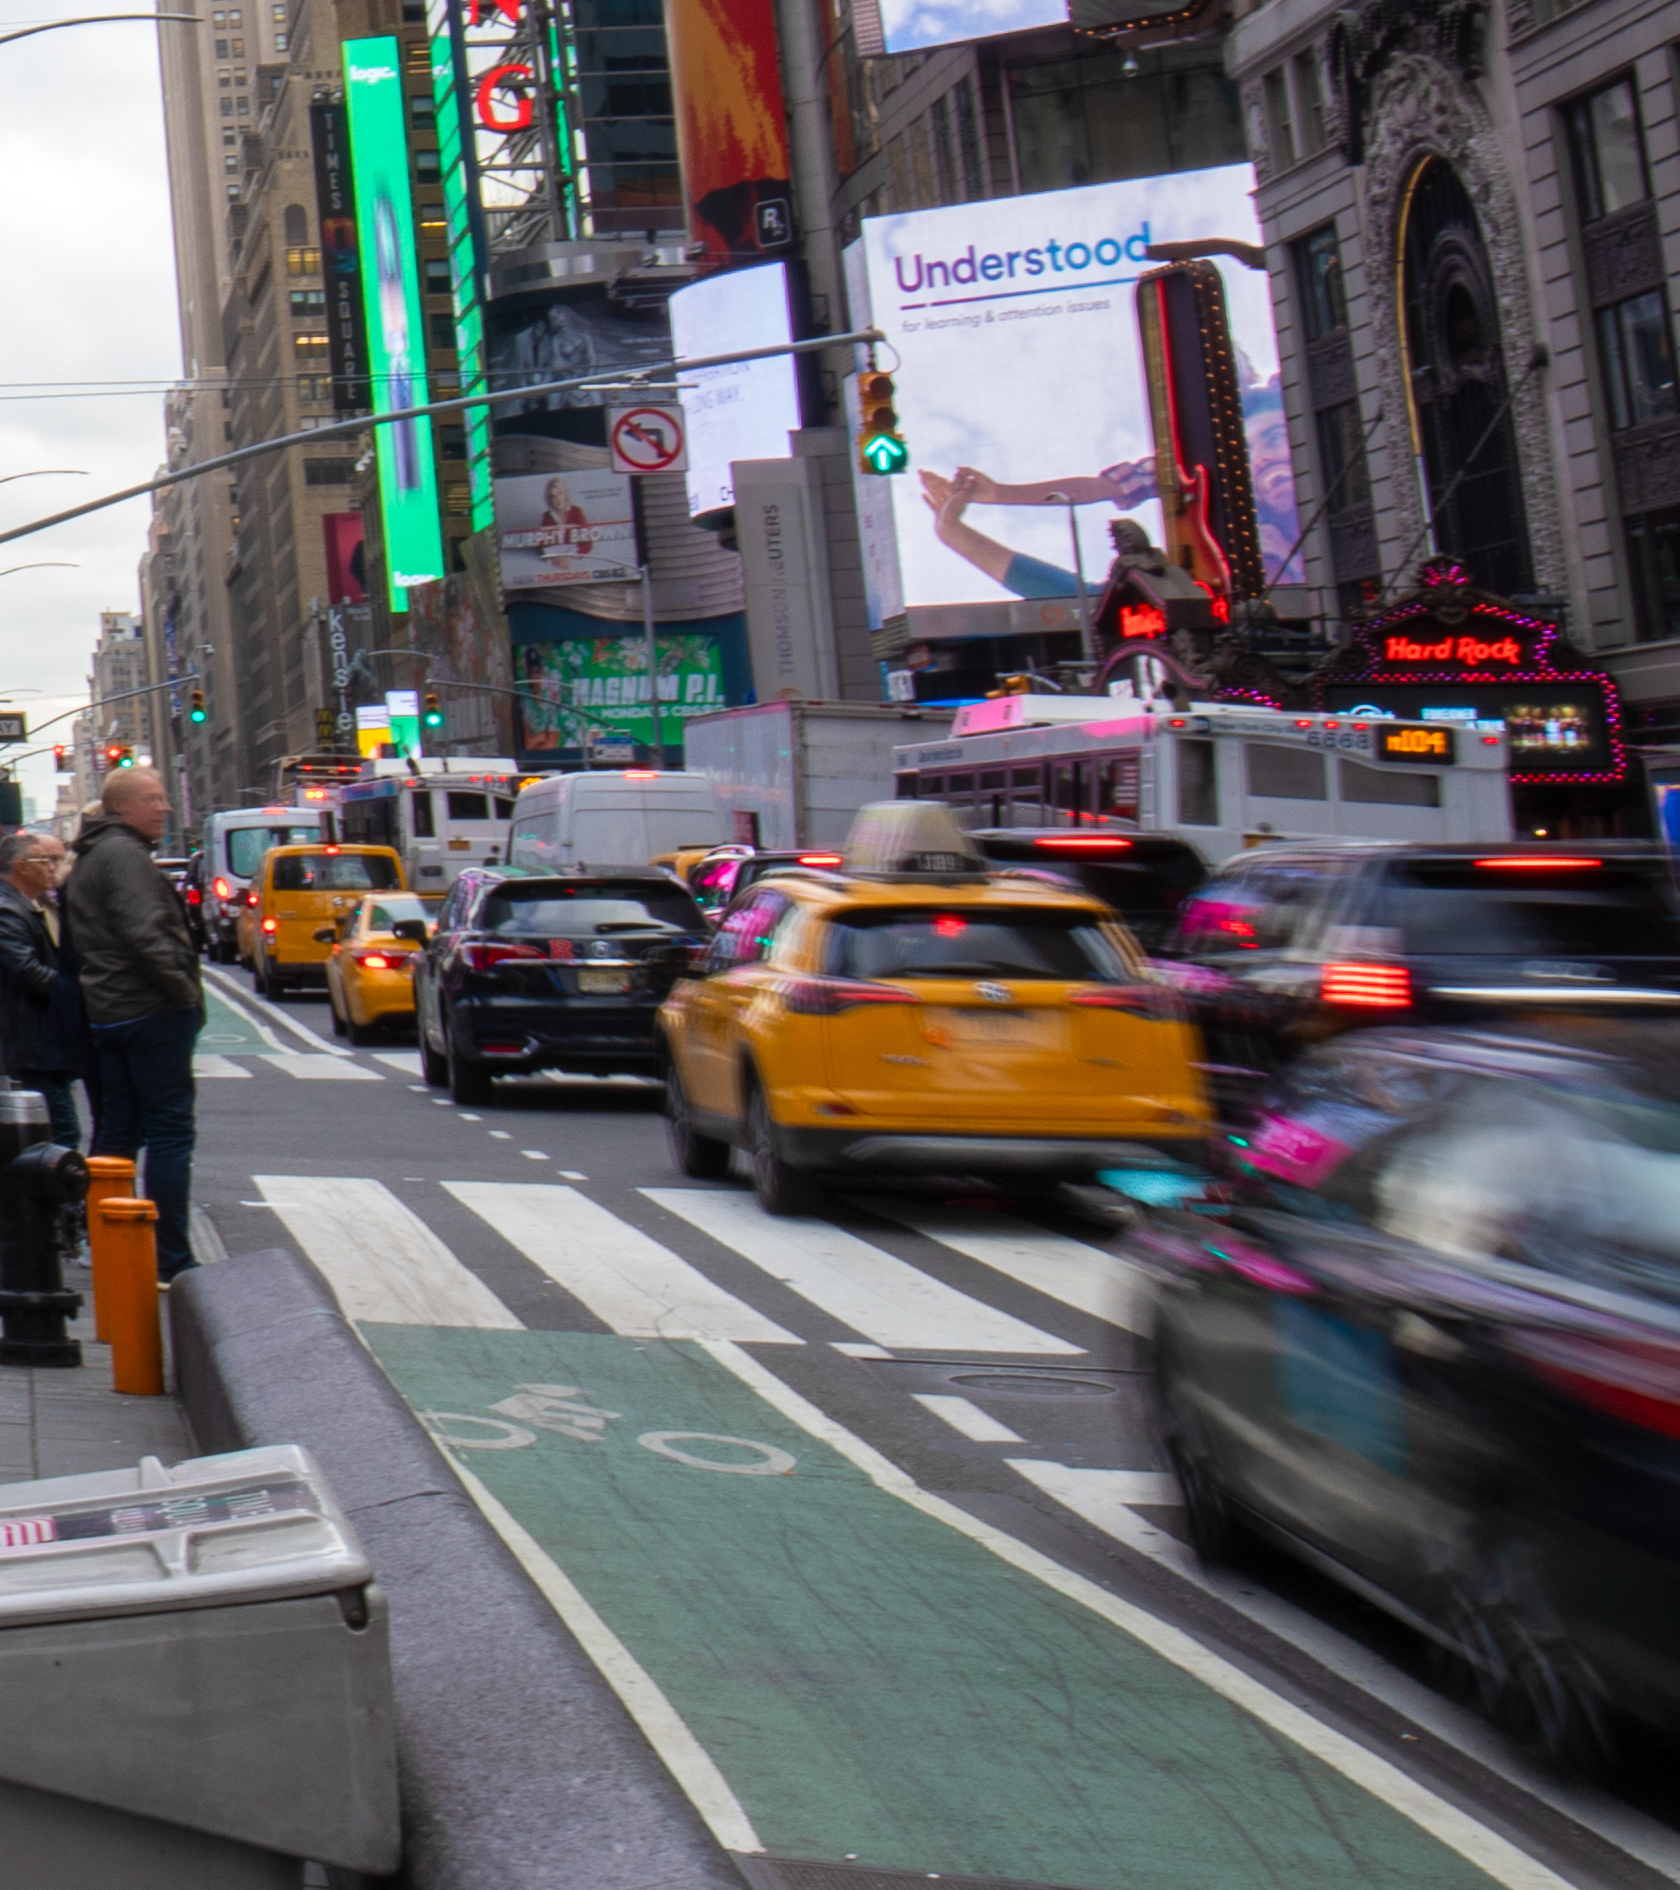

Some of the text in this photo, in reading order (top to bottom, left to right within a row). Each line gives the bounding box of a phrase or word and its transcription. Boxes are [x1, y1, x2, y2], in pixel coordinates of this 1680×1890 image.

[323, 113, 341, 210] TIMES
[894, 221, 1152, 294] Understood
[336, 279, 357, 401] SQUARE
[501, 525, 631, 550] MURPHY BROWN
[1385, 636, 1522, 666] Hard Rock
[572, 674, 680, 706] MAGNUM
